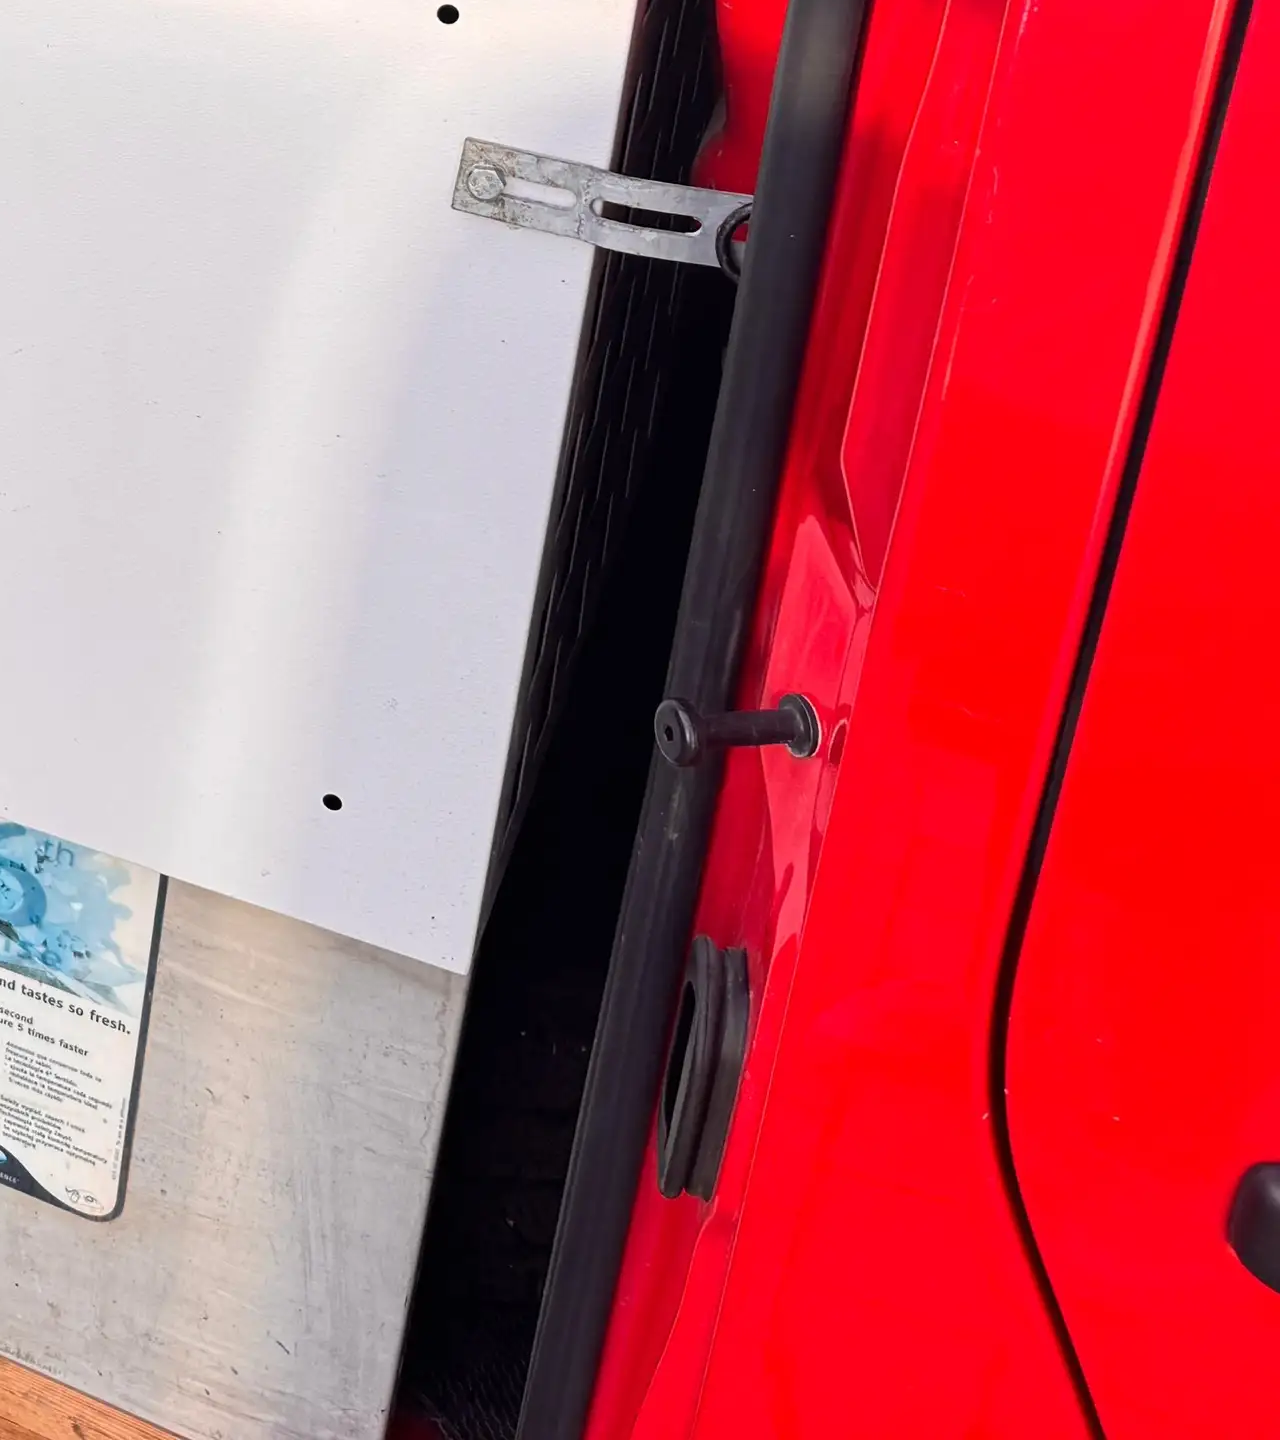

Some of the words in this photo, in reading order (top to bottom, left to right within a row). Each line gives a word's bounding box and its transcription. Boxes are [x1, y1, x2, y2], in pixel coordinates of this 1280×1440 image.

[0, 1006, 34, 1025] second
[21, 984, 64, 1009] tastes
[68, 1004, 84, 1017] so
[89, 1010, 131, 1035] fresh.
[17, 1023, 24, 1032] 5
[27, 1027, 55, 1044] times
[59, 1038, 89, 1056] faster
